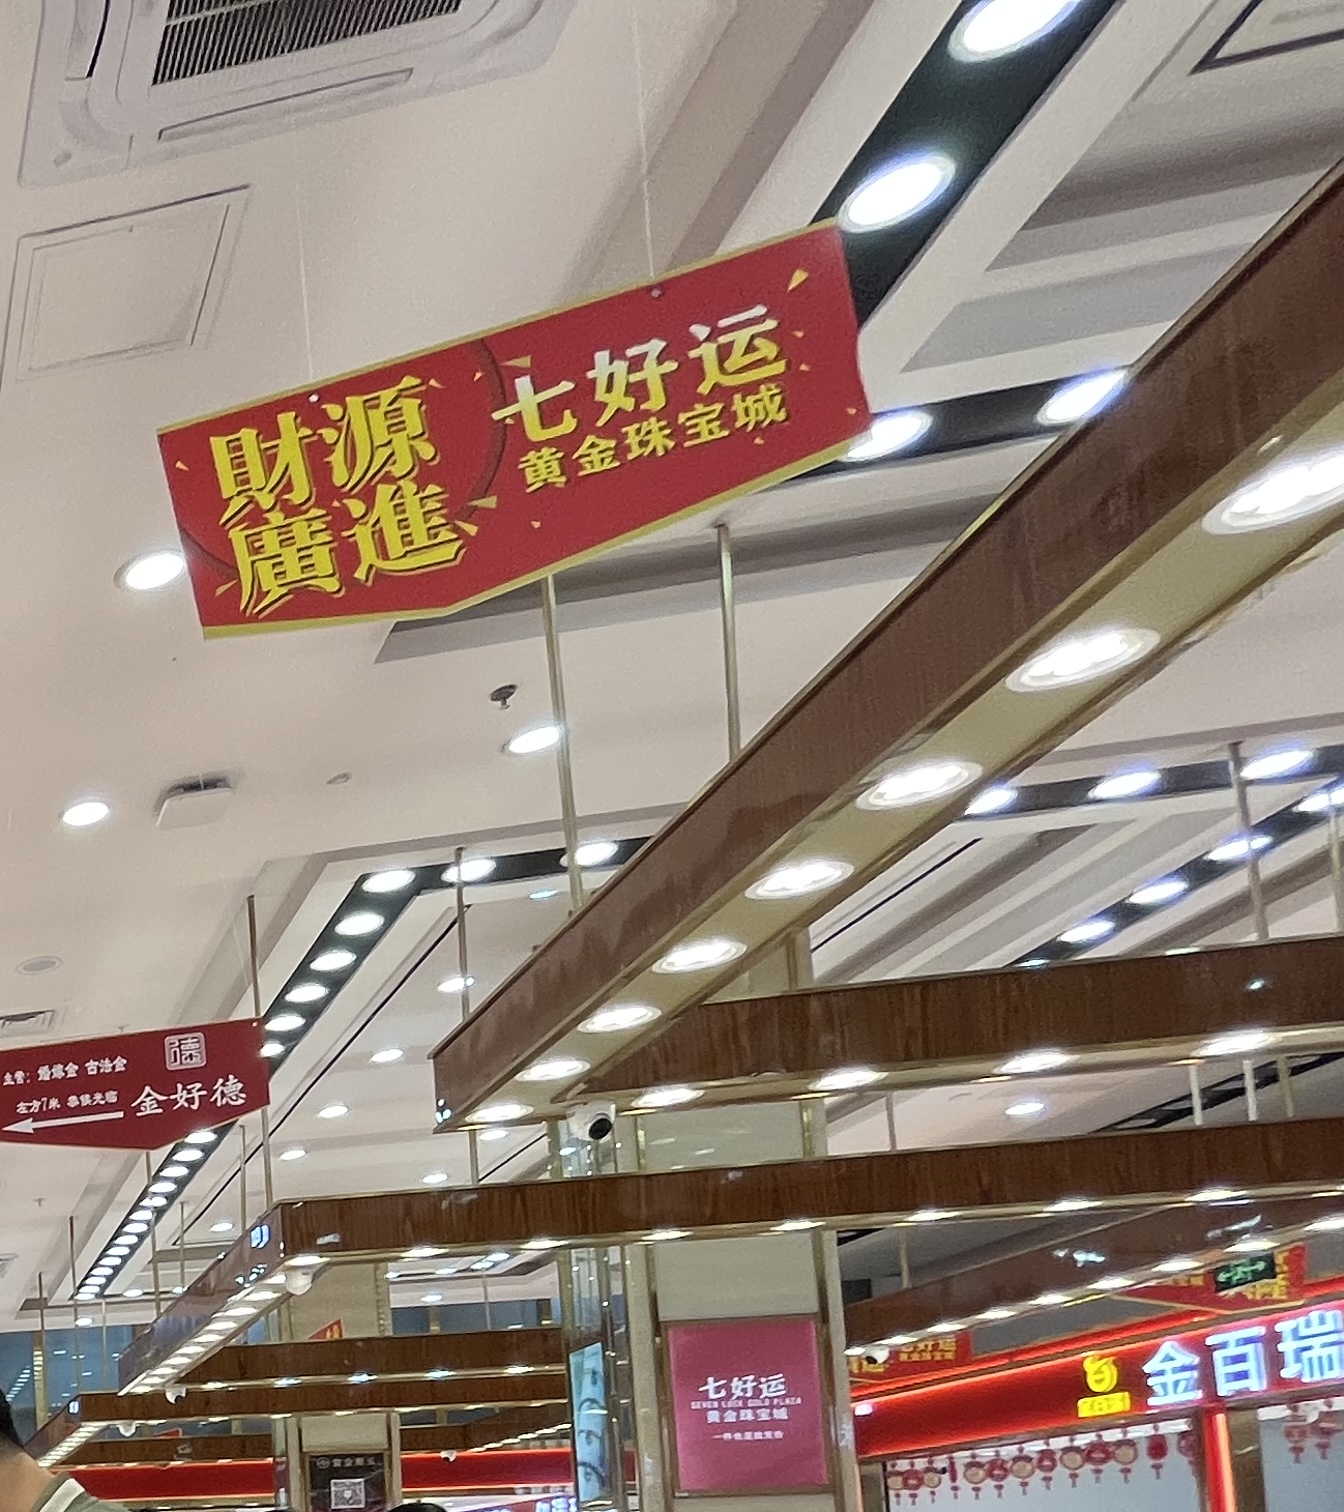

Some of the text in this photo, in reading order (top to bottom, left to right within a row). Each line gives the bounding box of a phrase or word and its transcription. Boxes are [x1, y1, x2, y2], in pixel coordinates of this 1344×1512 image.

[492, 305, 790, 444] 七好运
[210, 377, 440, 525] 財源
[518, 384, 790, 494] 黄金珠宝城
[228, 482, 462, 618] 廣進
[131, 1077, 247, 1118] 金好德
[698, 1373, 787, 1400] 七好运
[1142, 1309, 1344, 1406] 金百瑞
